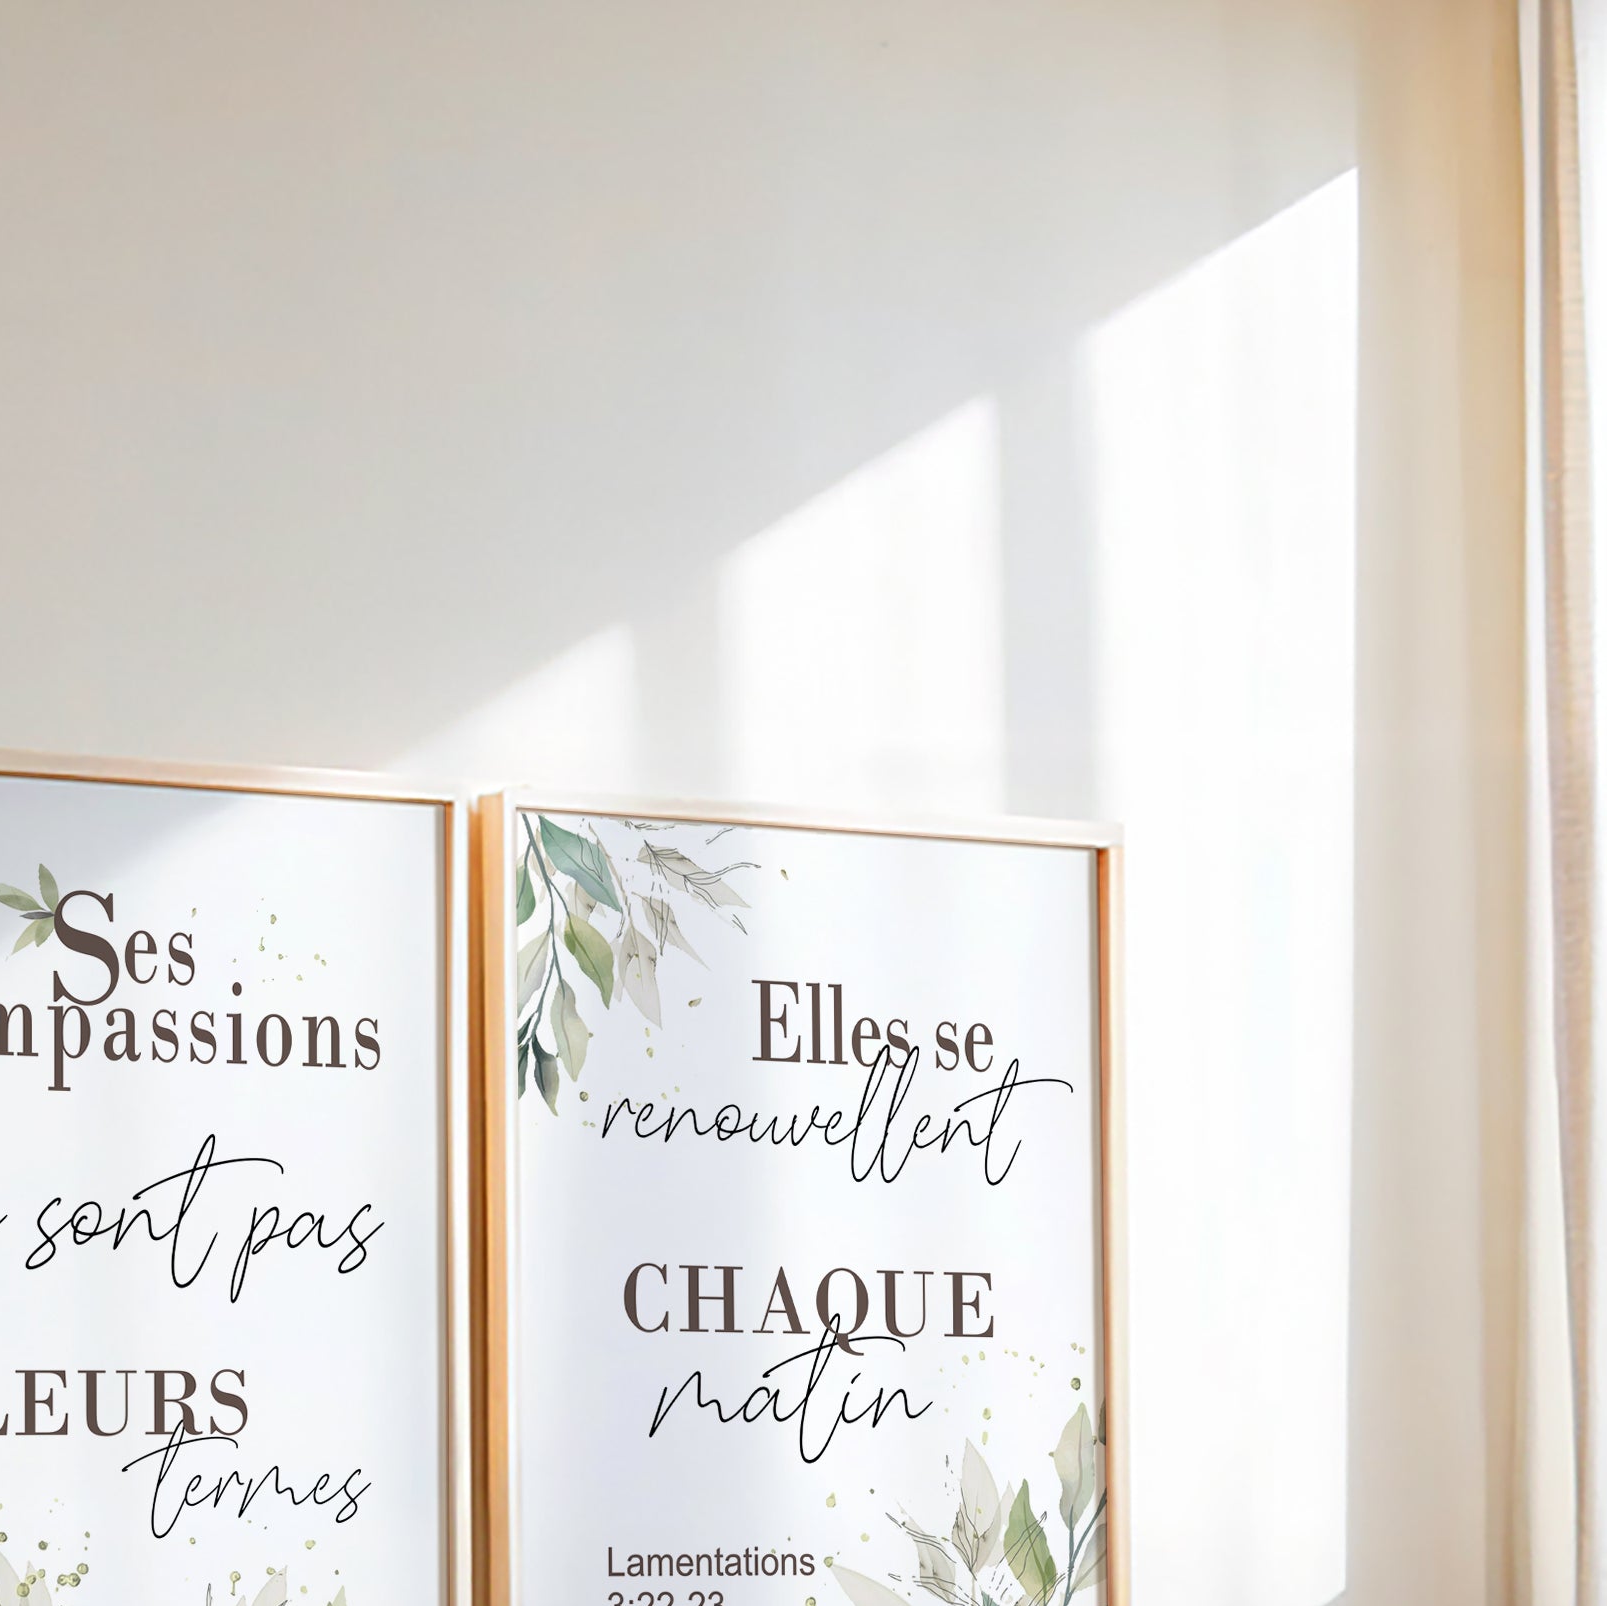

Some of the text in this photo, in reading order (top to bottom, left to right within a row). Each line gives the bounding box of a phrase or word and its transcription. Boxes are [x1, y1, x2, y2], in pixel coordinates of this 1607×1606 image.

[52, 890, 195, 1006] Ses
[751, 979, 994, 1073] Elles se
[602, 1044, 1074, 1187] renouvellent
[25, 1134, 284, 1289] sont
[230, 1203, 385, 1304] pas
[623, 1262, 994, 1356] CHAQUE
[649, 1313, 934, 1464] matin
[122, 1419, 372, 1539] termes
[607, 1546, 815, 1577] Lamentations
